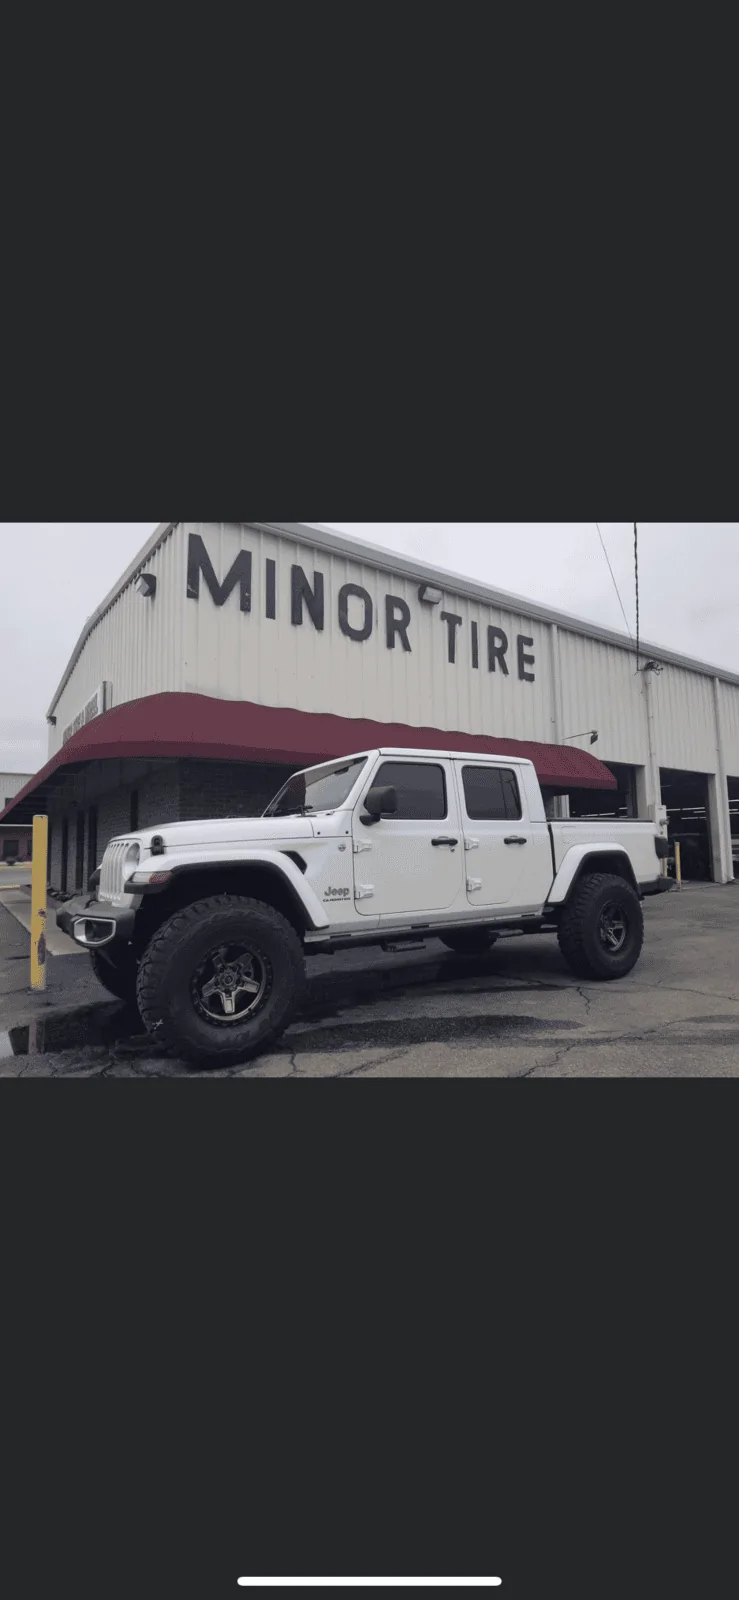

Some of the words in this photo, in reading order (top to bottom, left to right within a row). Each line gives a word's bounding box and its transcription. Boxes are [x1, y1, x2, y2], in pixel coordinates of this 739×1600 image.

[187, 533, 412, 652] MINOR
[441, 611, 535, 682] TIRE
[324, 886, 350, 897] Jeep
